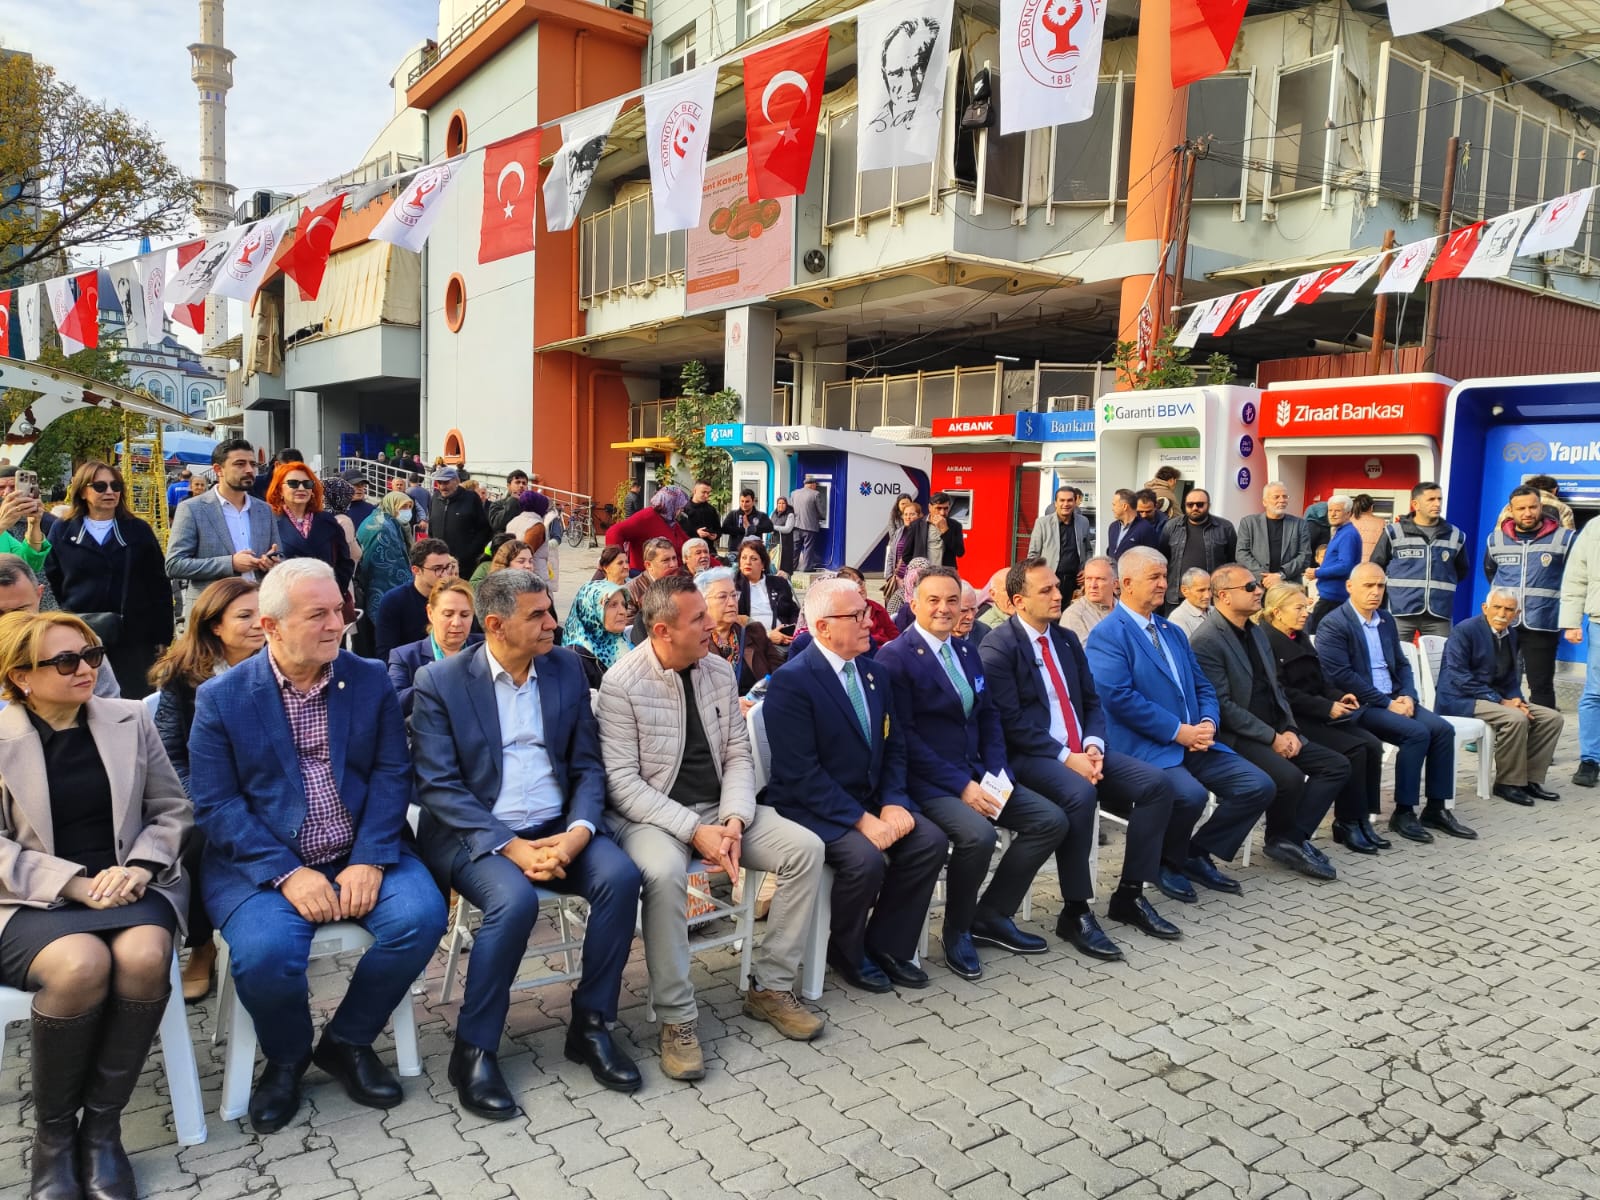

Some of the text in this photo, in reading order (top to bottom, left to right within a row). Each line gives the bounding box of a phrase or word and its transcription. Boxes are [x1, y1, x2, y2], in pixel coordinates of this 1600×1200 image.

[1051, 73, 1076, 84] 188
[661, 111, 680, 167] BORNOVA
[1115, 402, 1196, 420] Garanti BBVA
[1294, 402, 1404, 422] Ziraat Bankası
[948, 421, 994, 433] AKBANK
[783, 431, 800, 441] QNB
[873, 482, 902, 495] QNB
